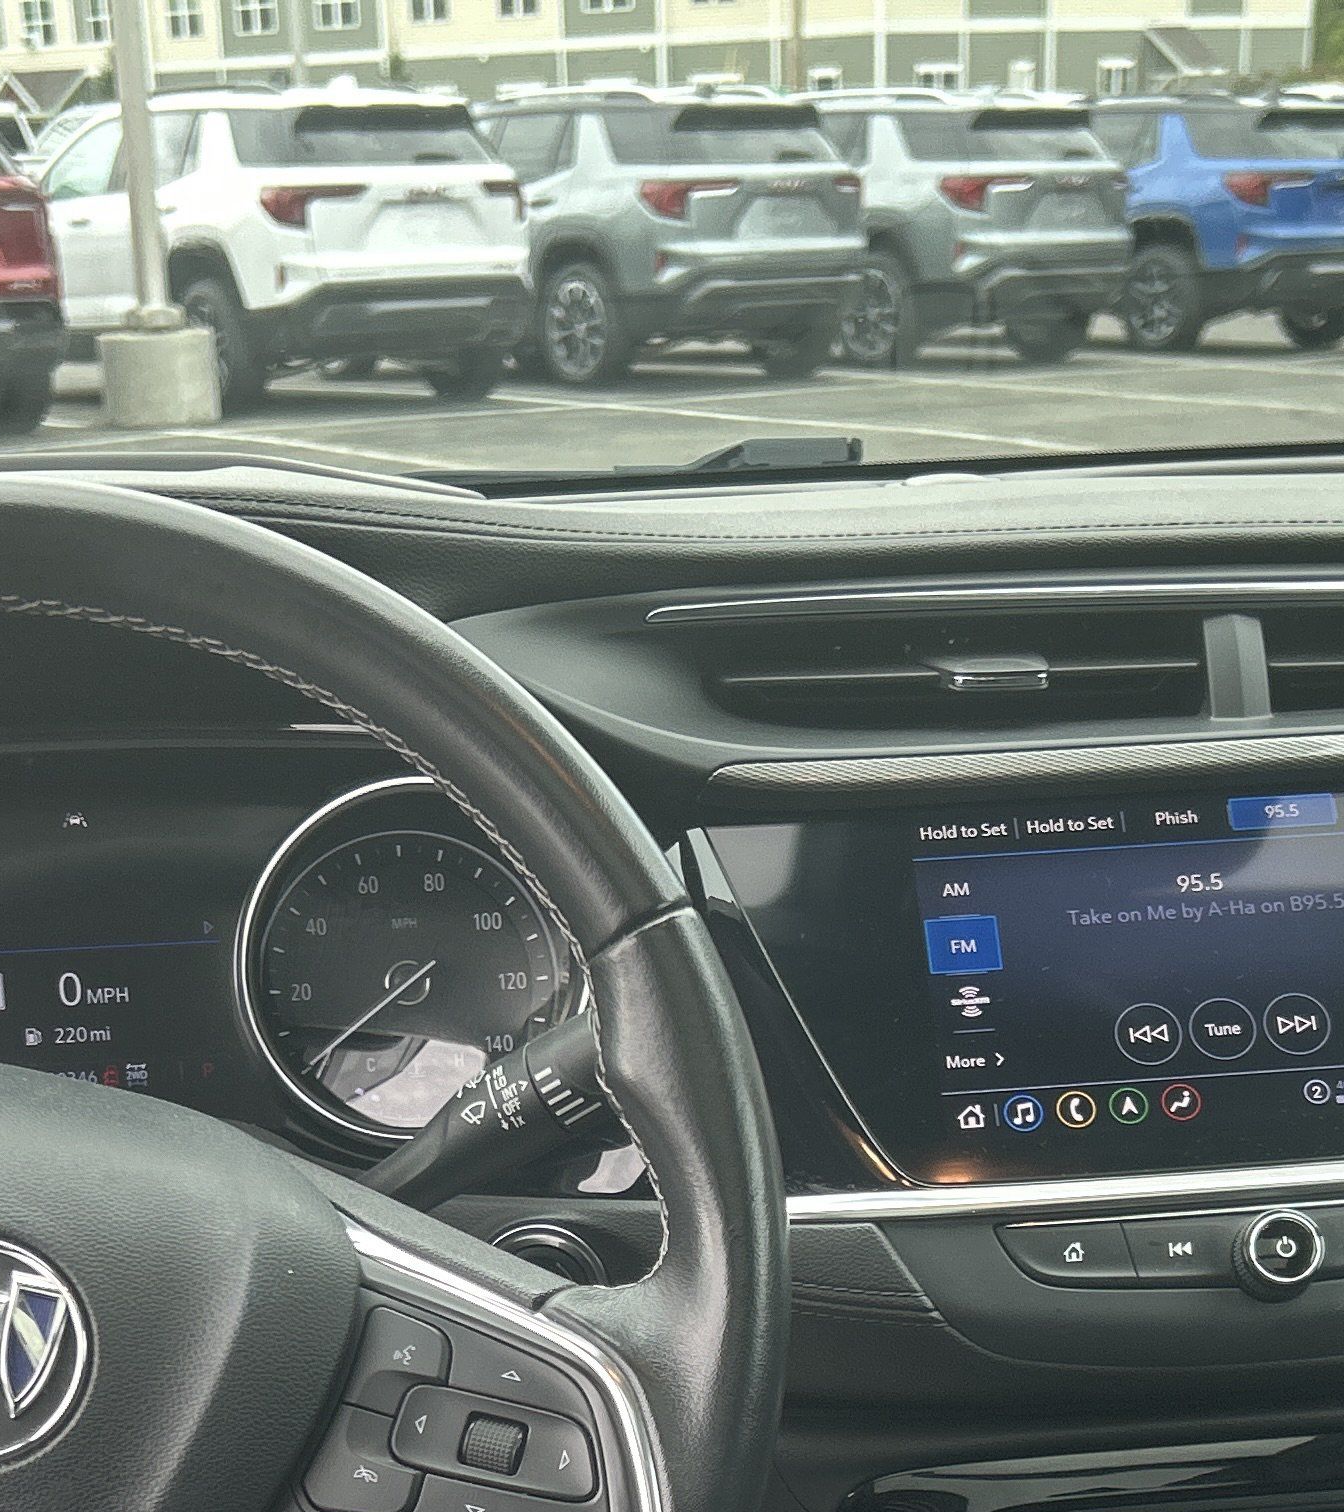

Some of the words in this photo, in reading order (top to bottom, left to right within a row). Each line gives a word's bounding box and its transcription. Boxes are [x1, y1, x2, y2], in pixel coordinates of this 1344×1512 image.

[1155, 809, 1199, 826] Phish
[1264, 803, 1301, 818] 95.5
[919, 824, 957, 841] Hold
[960, 825, 978, 839] to
[981, 823, 1008, 837] Set
[1026, 818, 1064, 834] Hold
[1067, 819, 1084, 832] to
[1087, 816, 1115, 831] Set
[358, 876, 379, 895] 60
[424, 873, 445, 892] 80
[942, 882, 971, 897] AM
[1176, 872, 1224, 893] 95.5
[473, 912, 503, 931] 100
[1066, 907, 1112, 927] Take
[1117, 908, 1142, 923] on
[1147, 904, 1177, 921] Me
[1181, 902, 1205, 924] by
[1208, 899, 1256, 917] A-Ha
[1262, 900, 1285, 914] on
[305, 918, 327, 936] 40
[950, 939, 977, 954] FM
[58, 971, 82, 1007] 0
[86, 986, 130, 1005] MPH
[497, 972, 528, 990] 120
[290, 984, 312, 1002] 20
[54, 1026, 87, 1045] 220
[90, 1026, 112, 1042] mi
[1204, 1022, 1242, 1037] Tune
[485, 1035, 514, 1055] 140
[946, 1054, 987, 1070] More
[494, 1075, 508, 1091] LO
[501, 1083, 518, 1102] INT
[502, 1096, 521, 1116] OFF
